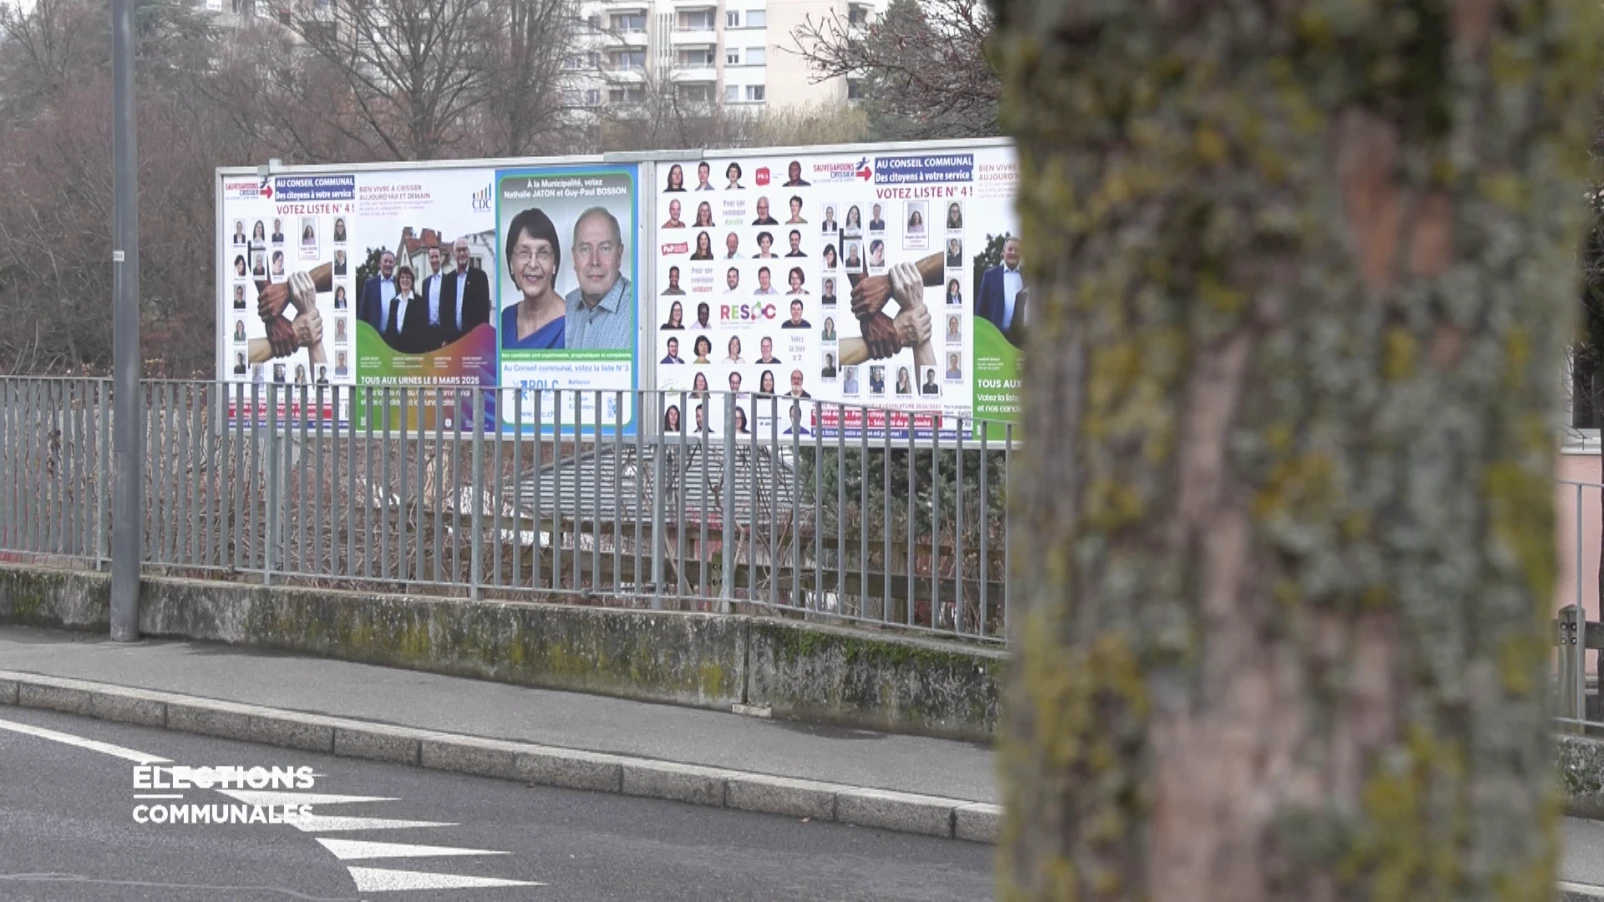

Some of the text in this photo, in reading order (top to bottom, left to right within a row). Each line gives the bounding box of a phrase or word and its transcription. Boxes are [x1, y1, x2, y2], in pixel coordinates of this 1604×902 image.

[877, 157, 973, 169] AU CONSEIL COMMUNAL
[979, 164, 995, 172] BIEN
[276, 176, 355, 188] AU CONSEIL COMMUNAL
[876, 174, 888, 182] Des
[889, 173, 918, 184] citoyens
[925, 172, 943, 181] votre
[944, 171, 969, 180] service
[396, 184, 422, 192] CRISSIER
[533, 180, 540, 188] la
[541, 178, 583, 190] Municipalité,
[584, 179, 603, 187] votez
[276, 192, 286, 200] Des
[287, 191, 310, 201] citoyens
[315, 190, 331, 199] votre
[331, 189, 352, 198] service
[407, 192, 431, 200] DEMAIN
[503, 191, 531, 199] Nathalie
[532, 189, 556, 198] JATON
[564, 187, 596, 197] Guy-Paul
[596, 186, 627, 196] BOSSON
[876, 188, 911, 199] VOTEZ
[914, 187, 943, 198] LISTE
[946, 187, 958, 197] N°
[961, 187, 967, 197] 4
[277, 204, 305, 214] VOTEZ
[307, 204, 331, 214] LISTE
[332, 203, 343, 213] N°
[344, 203, 350, 213] 4
[472, 199, 492, 210] CDC
[513, 364, 537, 372] Conseil
[538, 364, 574, 373] communal,
[574, 364, 593, 372] votez
[600, 364, 615, 372] liste
[360, 375, 480, 385] TOUS AUX URNES LE 8 MARS 2026
[977, 379, 1023, 388] TOUS AUX
[976, 393, 996, 402] Votez
[997, 393, 1005, 402] la
[976, 404, 985, 413] et
[985, 404, 999, 413] nos
